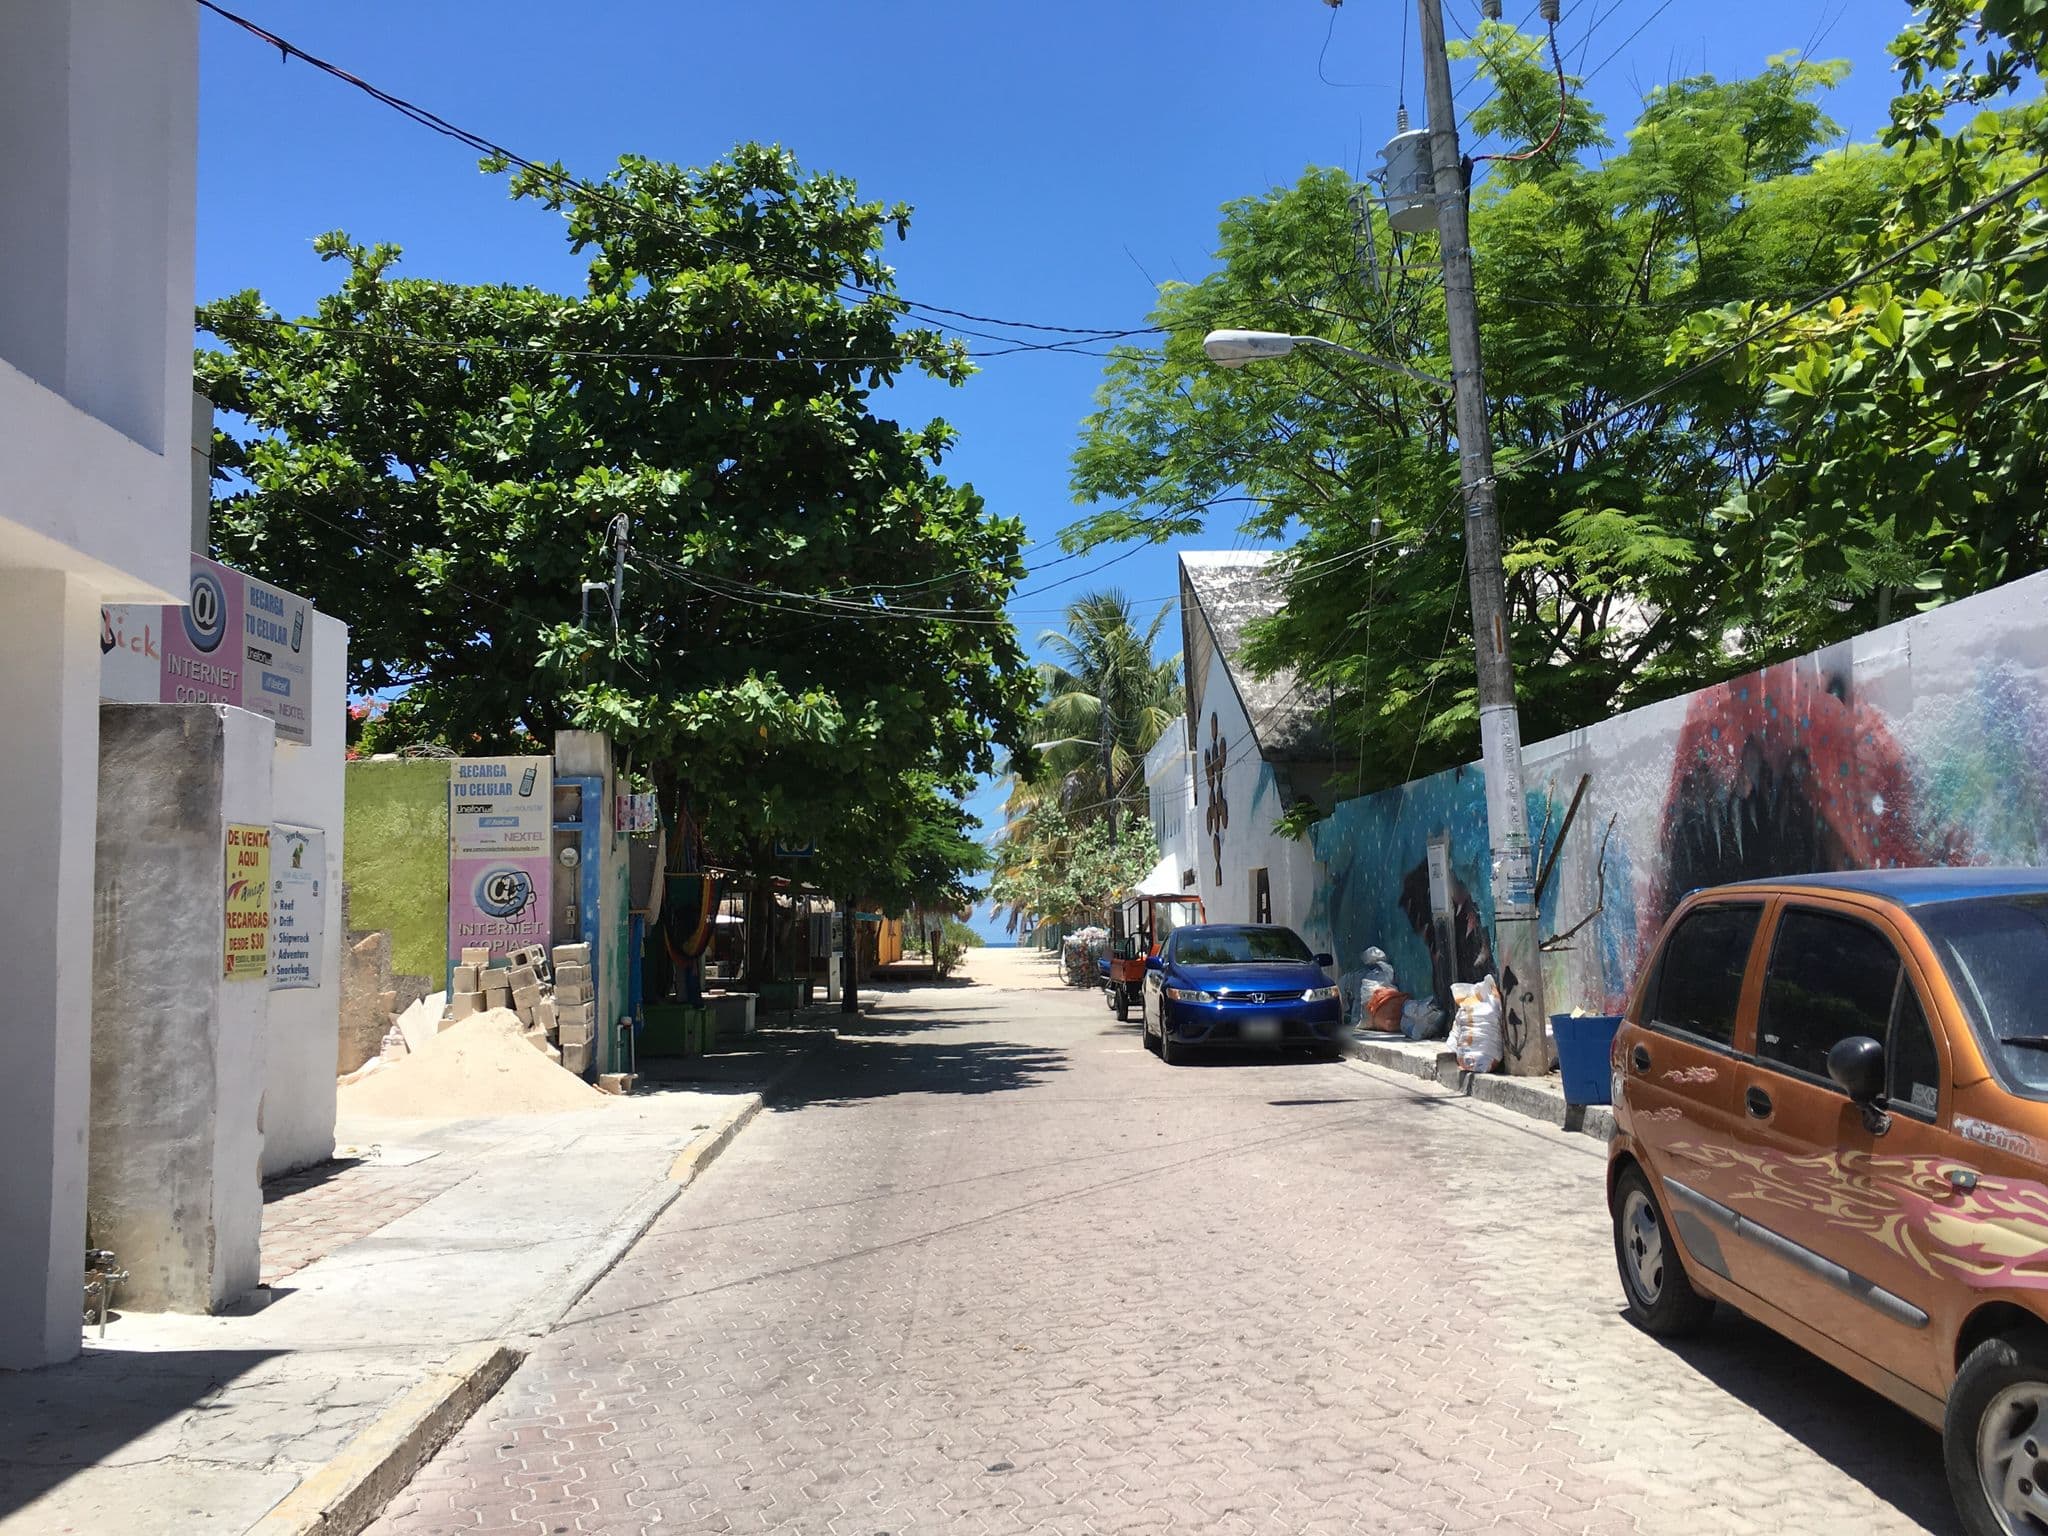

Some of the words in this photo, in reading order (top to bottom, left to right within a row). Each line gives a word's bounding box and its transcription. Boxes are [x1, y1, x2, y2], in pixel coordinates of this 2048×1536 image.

[250, 587, 285, 617] RECARGA
[246, 613, 256, 635] TU
[256, 618, 288, 646] CELULAR
[167, 653, 239, 690] INTERNET
[279, 703, 305, 721] NEXTEL
[459, 765, 507, 778] RECARGA
[453, 784, 466, 797] TU
[469, 783, 513, 797] CELULAR
[228, 830, 240, 845] DE
[242, 831, 269, 848] VENTA
[504, 832, 545, 842] NEXTEL
[238, 851, 259, 866] AQUI
[279, 900, 294, 911] Reef
[226, 912, 268, 928] RECARGAS
[279, 915, 294, 927] Drift
[459, 921, 543, 936] INTERNET
[229, 938, 249, 950] DESDE
[279, 932, 310, 946] Shipwreck
[278, 949, 309, 960] Adventure
[276, 962, 309, 976] Snorkeling
